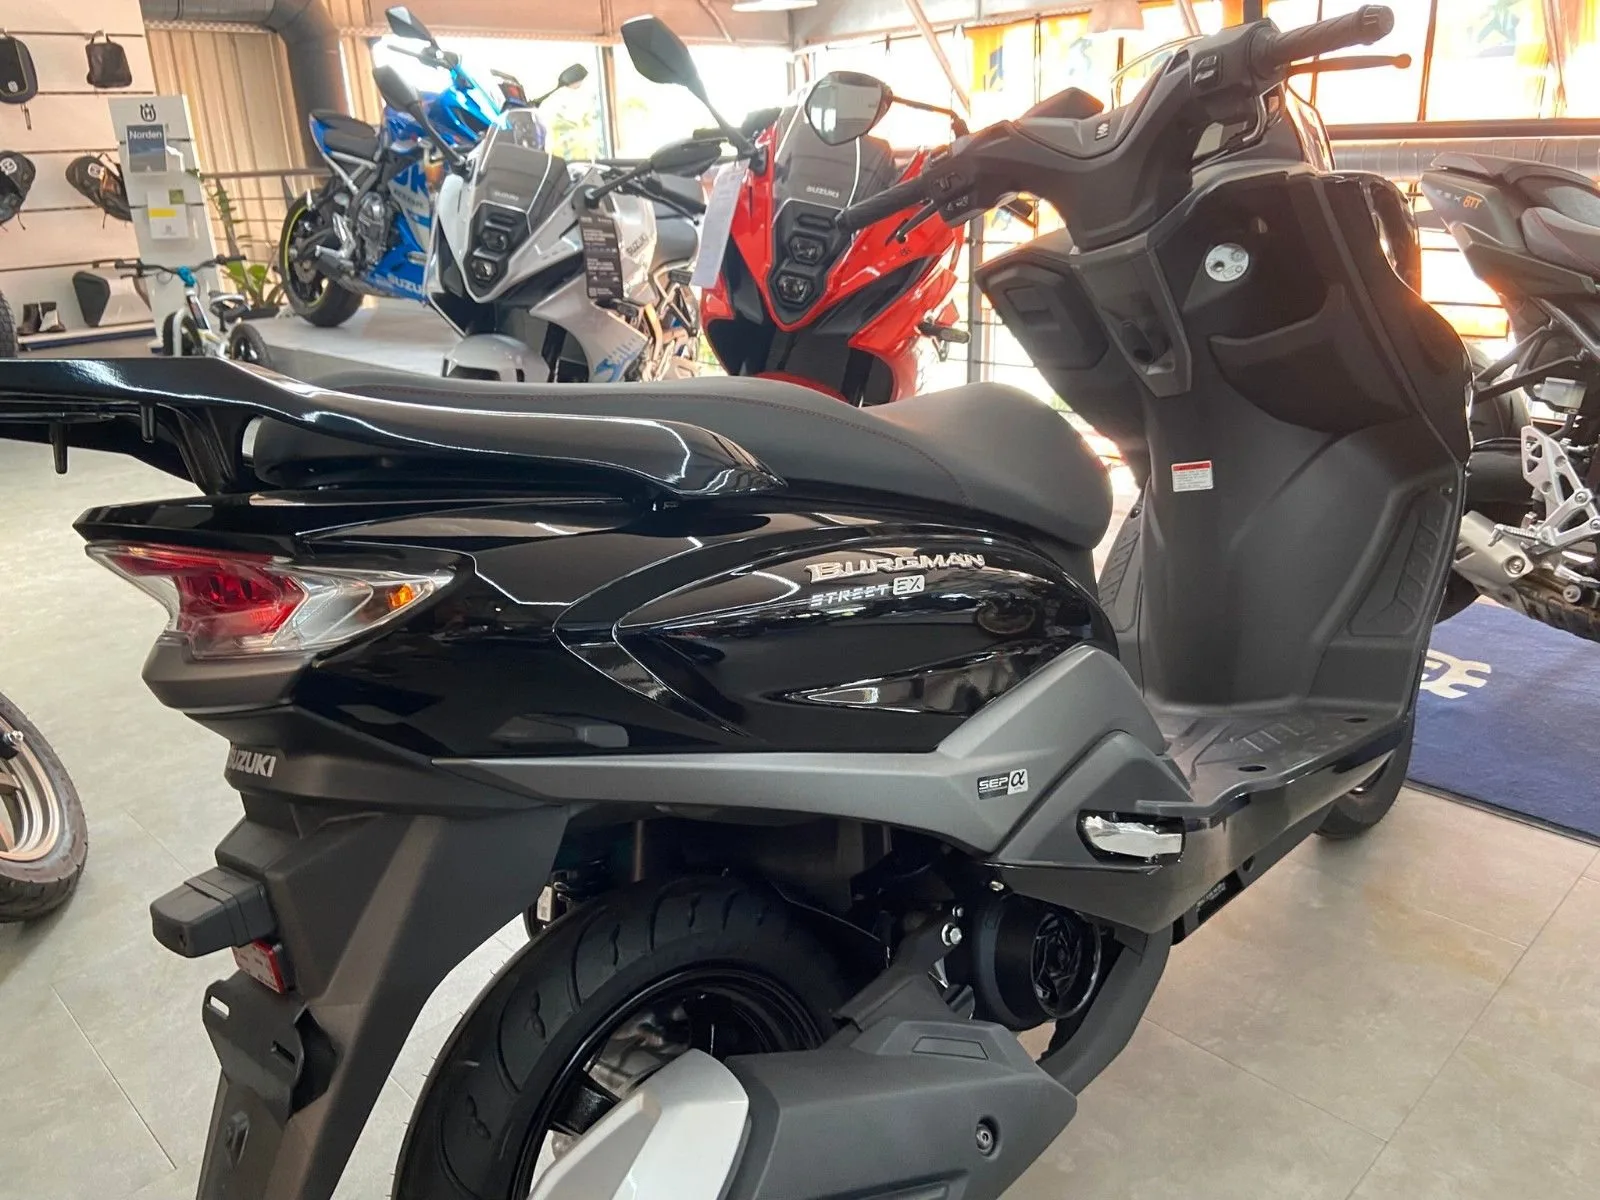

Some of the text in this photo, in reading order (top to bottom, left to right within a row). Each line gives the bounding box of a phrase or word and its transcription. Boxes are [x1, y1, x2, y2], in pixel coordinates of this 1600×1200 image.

[129, 130, 163, 140] Norden
[806, 185, 840, 199] SUZUKI
[804, 552, 986, 583] BURGMAN
[810, 577, 923, 607] STREET EX
[978, 776, 1009, 790] SEP
